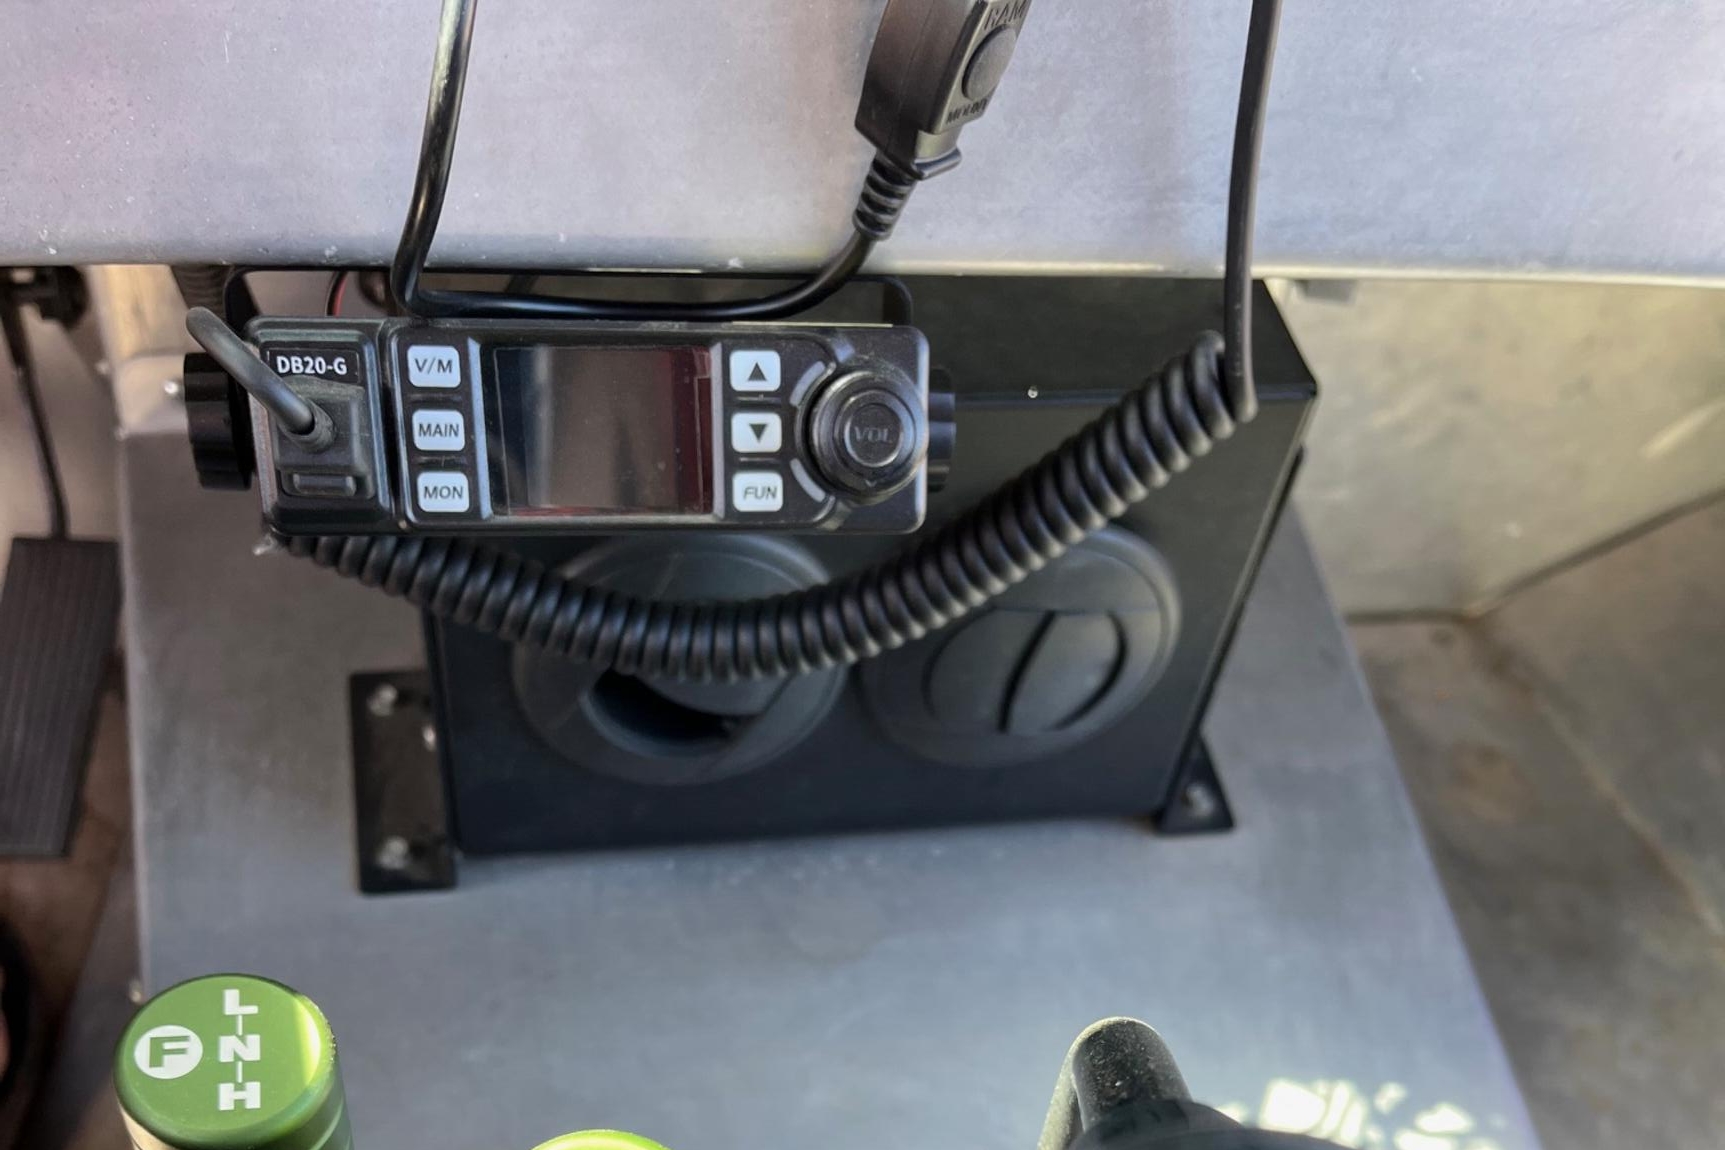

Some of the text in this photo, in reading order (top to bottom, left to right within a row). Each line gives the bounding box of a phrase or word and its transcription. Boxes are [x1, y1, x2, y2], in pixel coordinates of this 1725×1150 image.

[276, 355, 348, 375] DB20-G
[415, 358, 454, 374] V/M
[418, 424, 460, 439] MAIN
[855, 426, 894, 444] VOL
[424, 484, 464, 499] MON
[744, 486, 778, 500] FUN
[224, 989, 258, 1015] L
[148, 1036, 192, 1068] F
[219, 1034, 261, 1062] N
[218, 1081, 261, 1111] H
